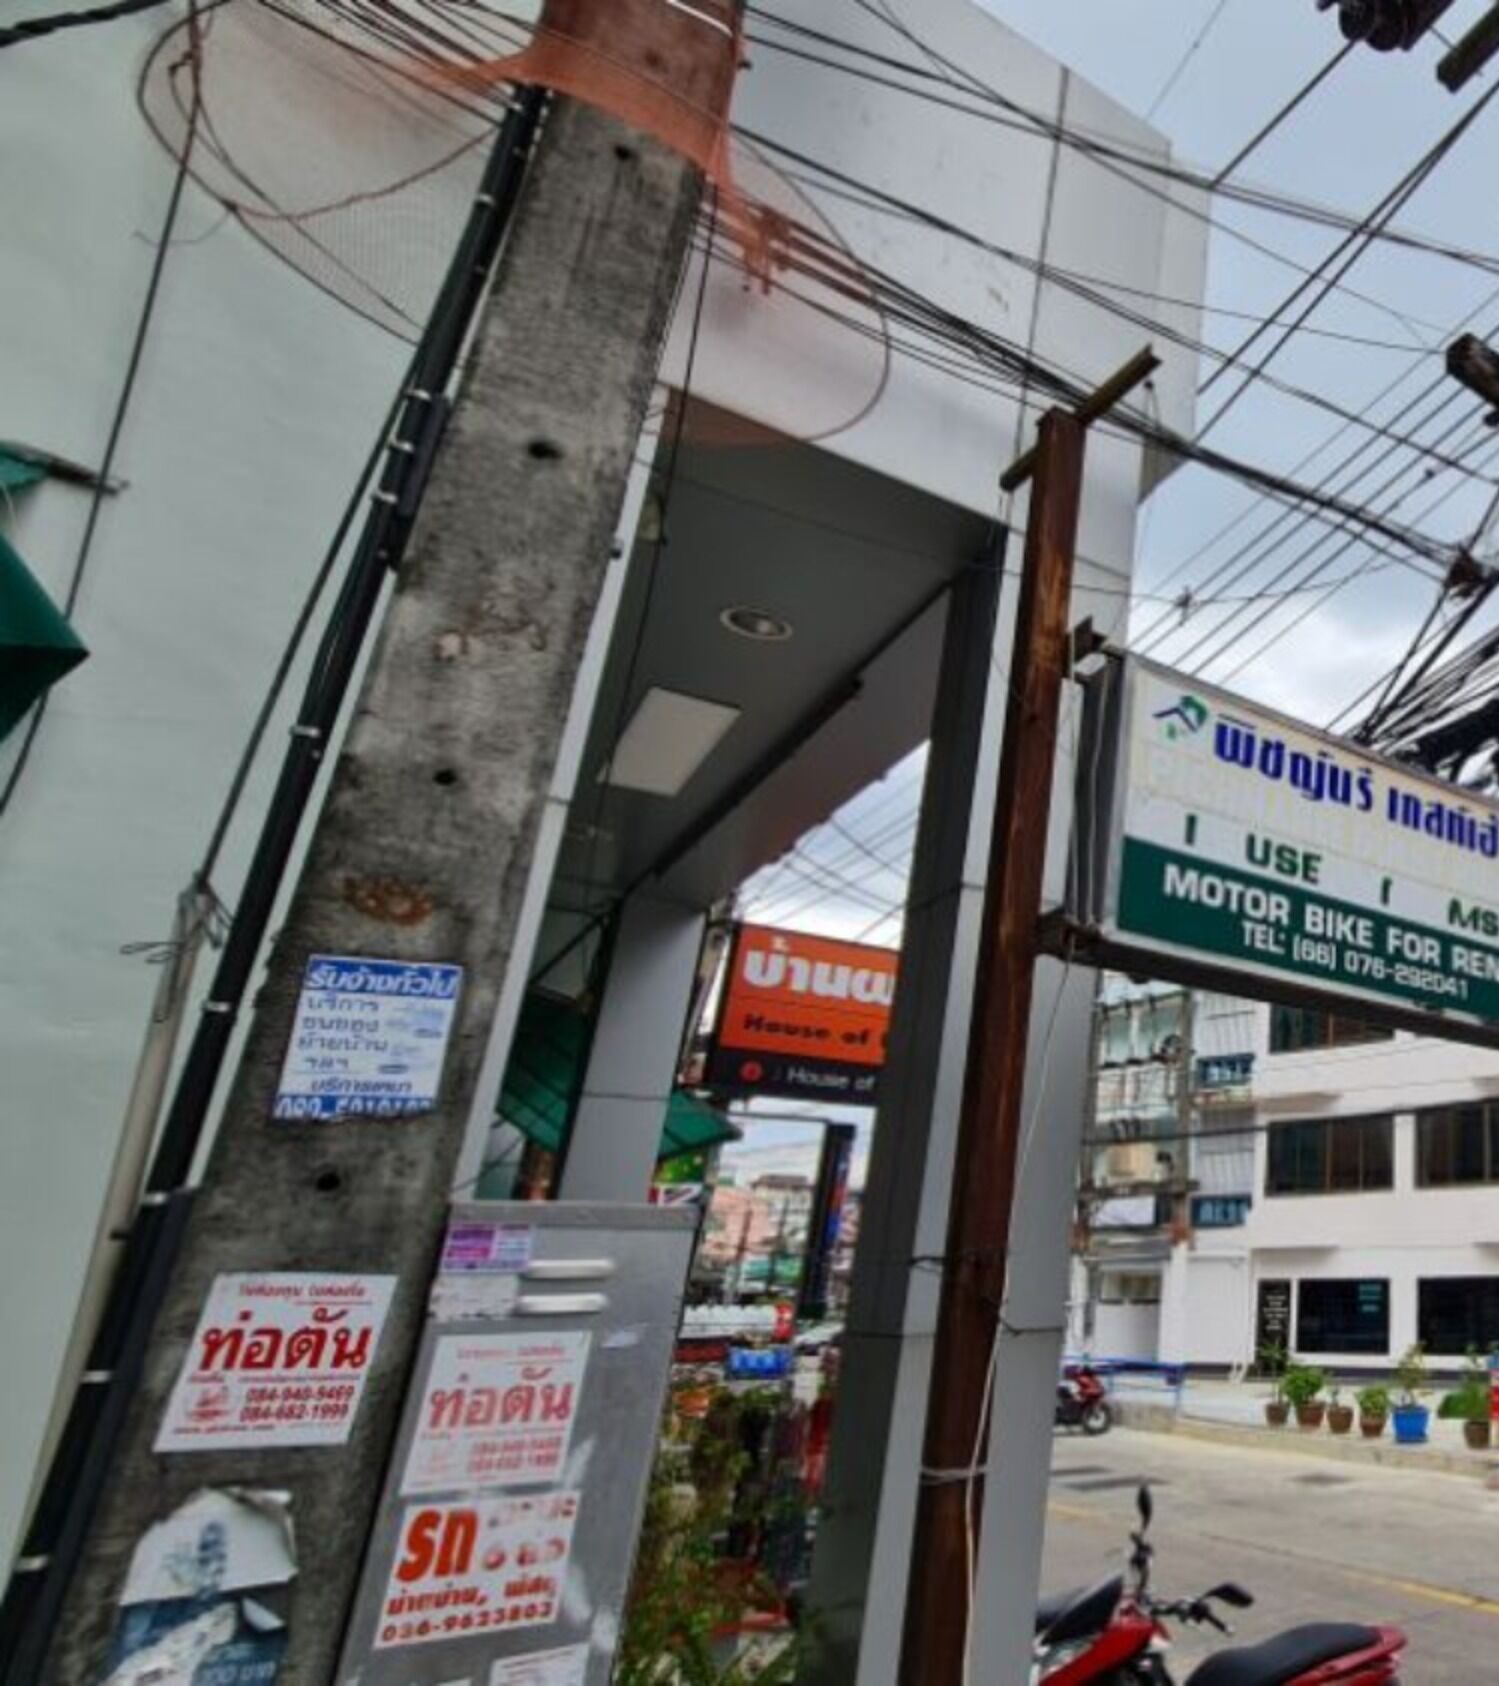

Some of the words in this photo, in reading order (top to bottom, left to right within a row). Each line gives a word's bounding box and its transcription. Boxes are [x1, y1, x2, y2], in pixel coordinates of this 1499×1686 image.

[1163, 863, 1289, 926] MOTOR
[1304, 905, 1374, 949] BIKE
[1386, 927, 1441, 966] FOR
[1246, 834, 1324, 885] USE
[1448, 898, 1499, 937] MS
[1293, 934, 1338, 971] (66)
[1344, 950, 1469, 999] 076-292041
[743, 1013, 831, 1039] House
[841, 1029, 870, 1045] of
[787, 1066, 849, 1089] House
[855, 1076, 876, 1091] of
[199, 1307, 373, 1371] ท่อตัน
[428, 1367, 574, 1429] ท่อตัน
[396, 1508, 478, 1583] รถ
